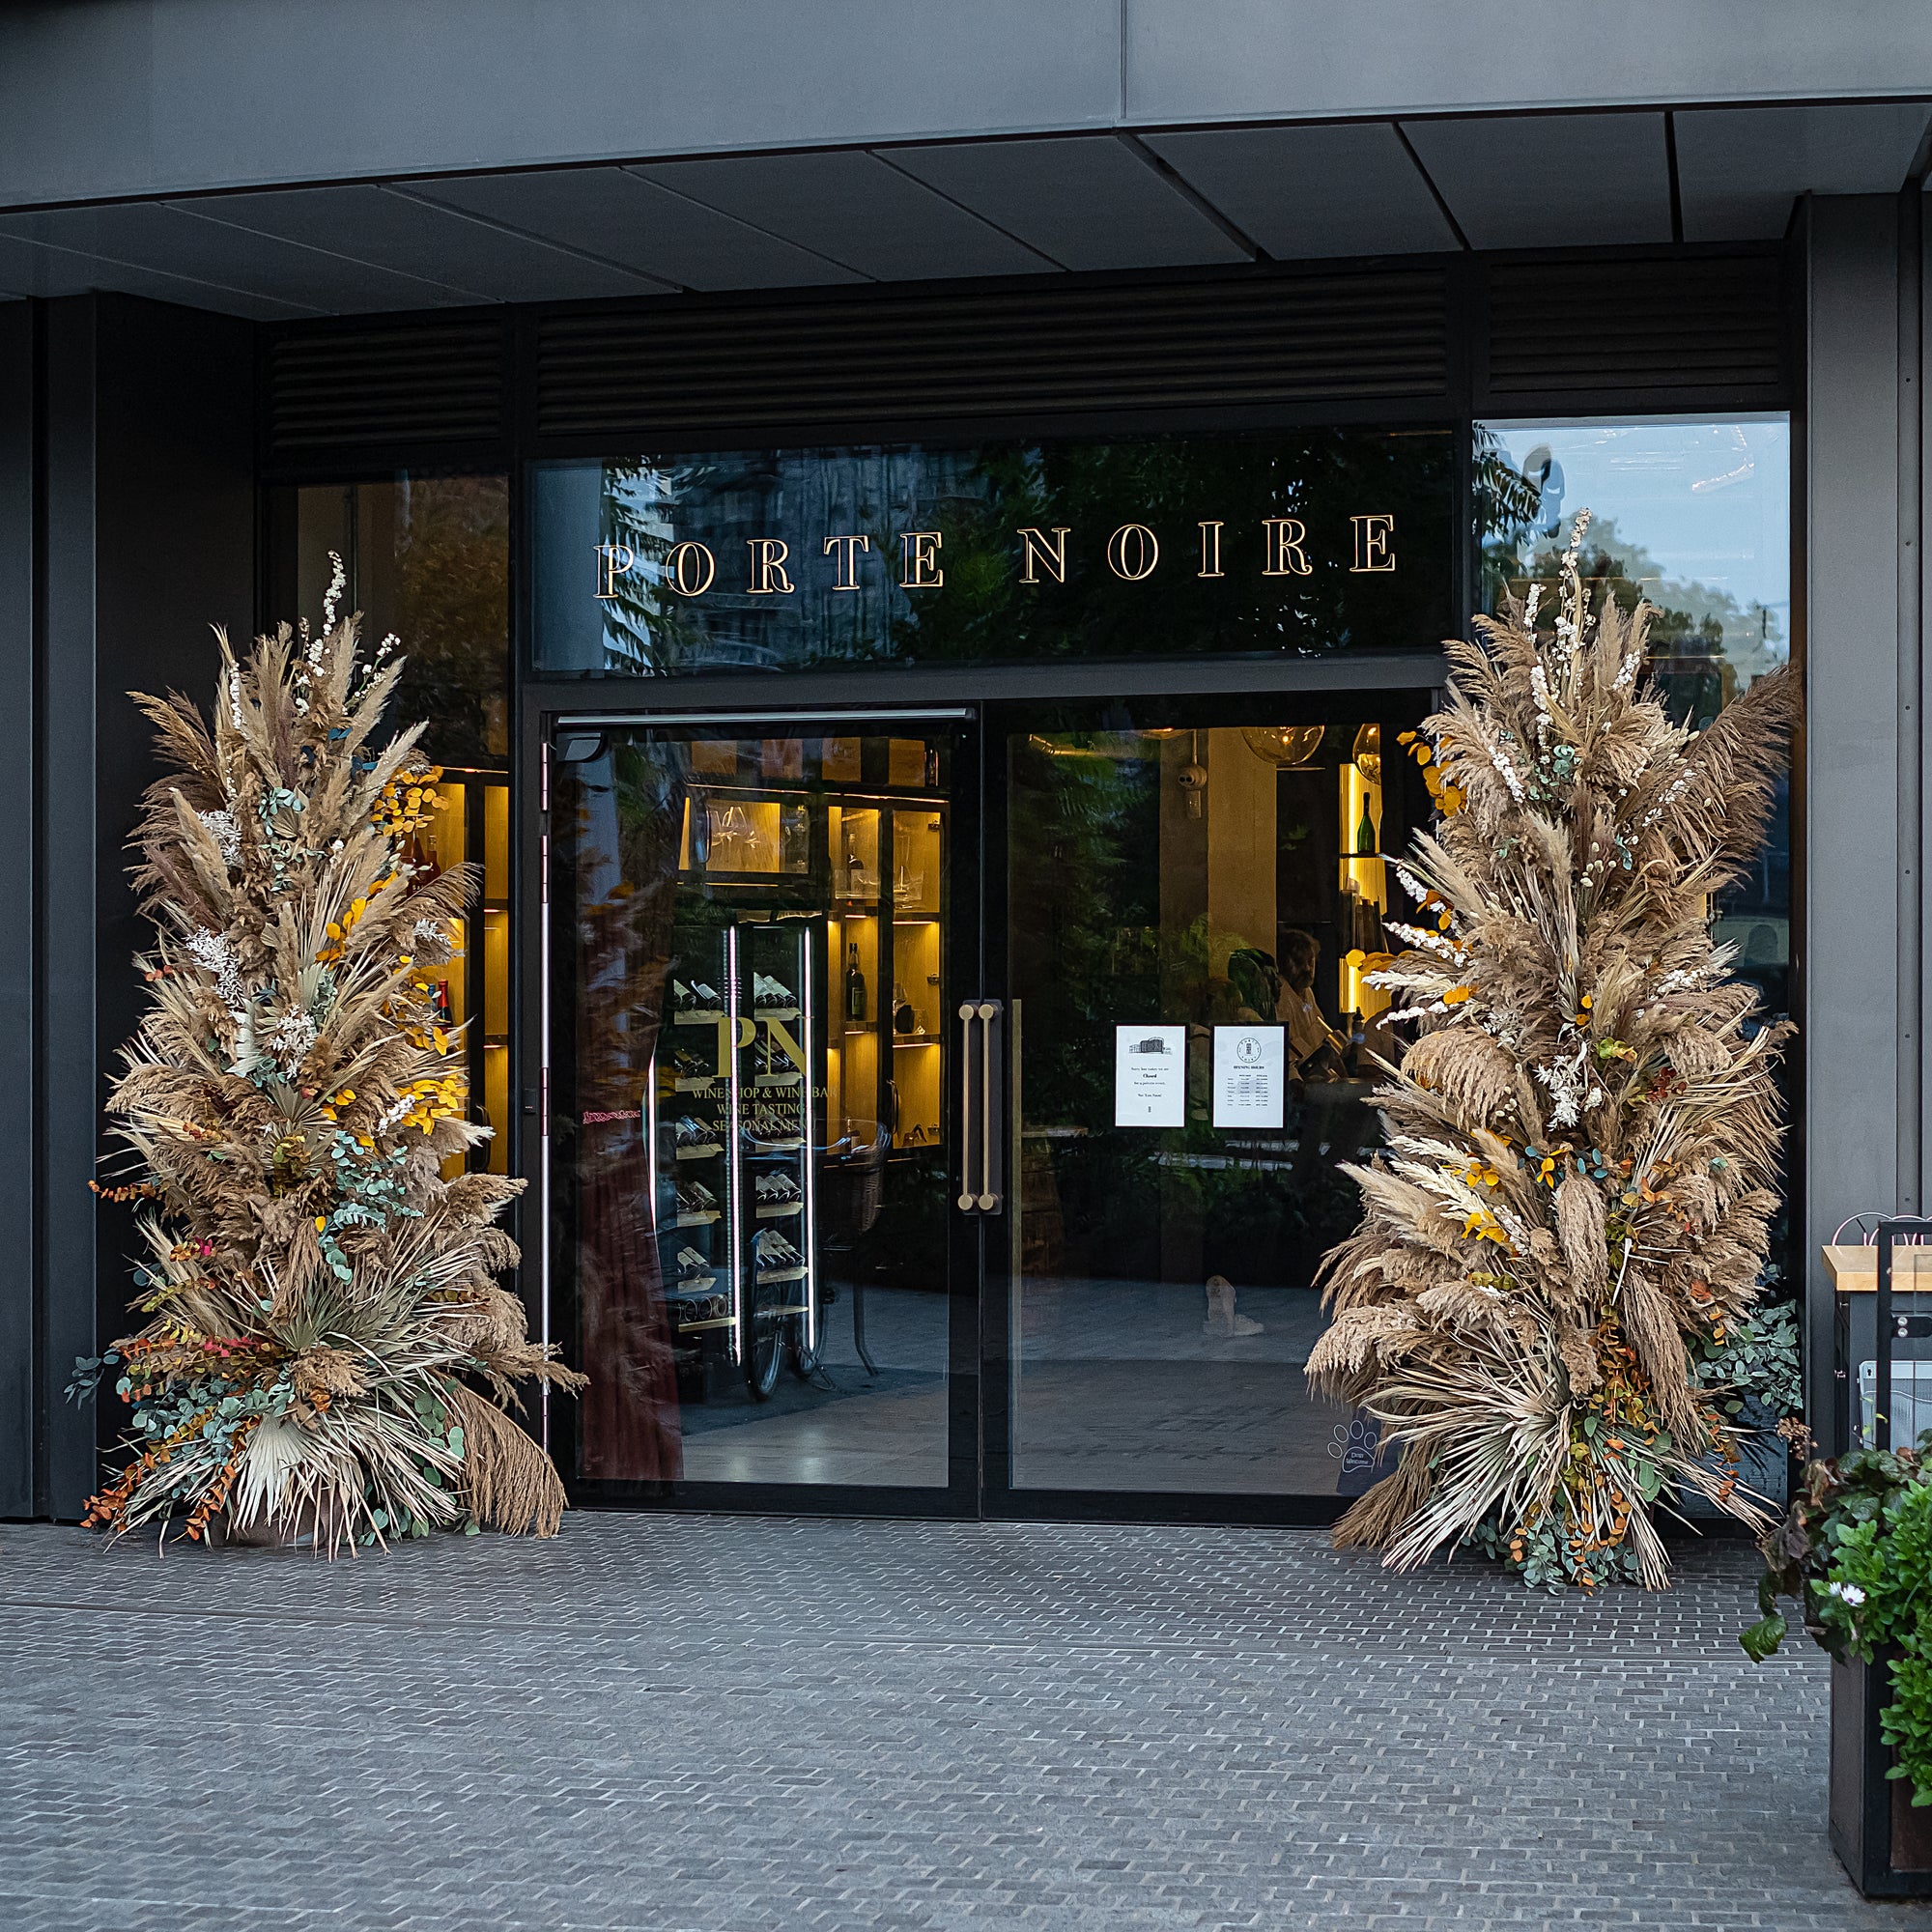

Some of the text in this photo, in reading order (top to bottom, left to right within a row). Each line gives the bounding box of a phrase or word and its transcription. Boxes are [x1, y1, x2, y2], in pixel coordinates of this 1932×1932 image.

[593, 515, 1395, 599] PORTE NOIRE
[712, 1016, 814, 1078] PN
[693, 1087, 725, 1099] WINE
[762, 1087, 772, 1098] &
[812, 1086, 838, 1098] BAR
[752, 1103, 806, 1115] TASTING
